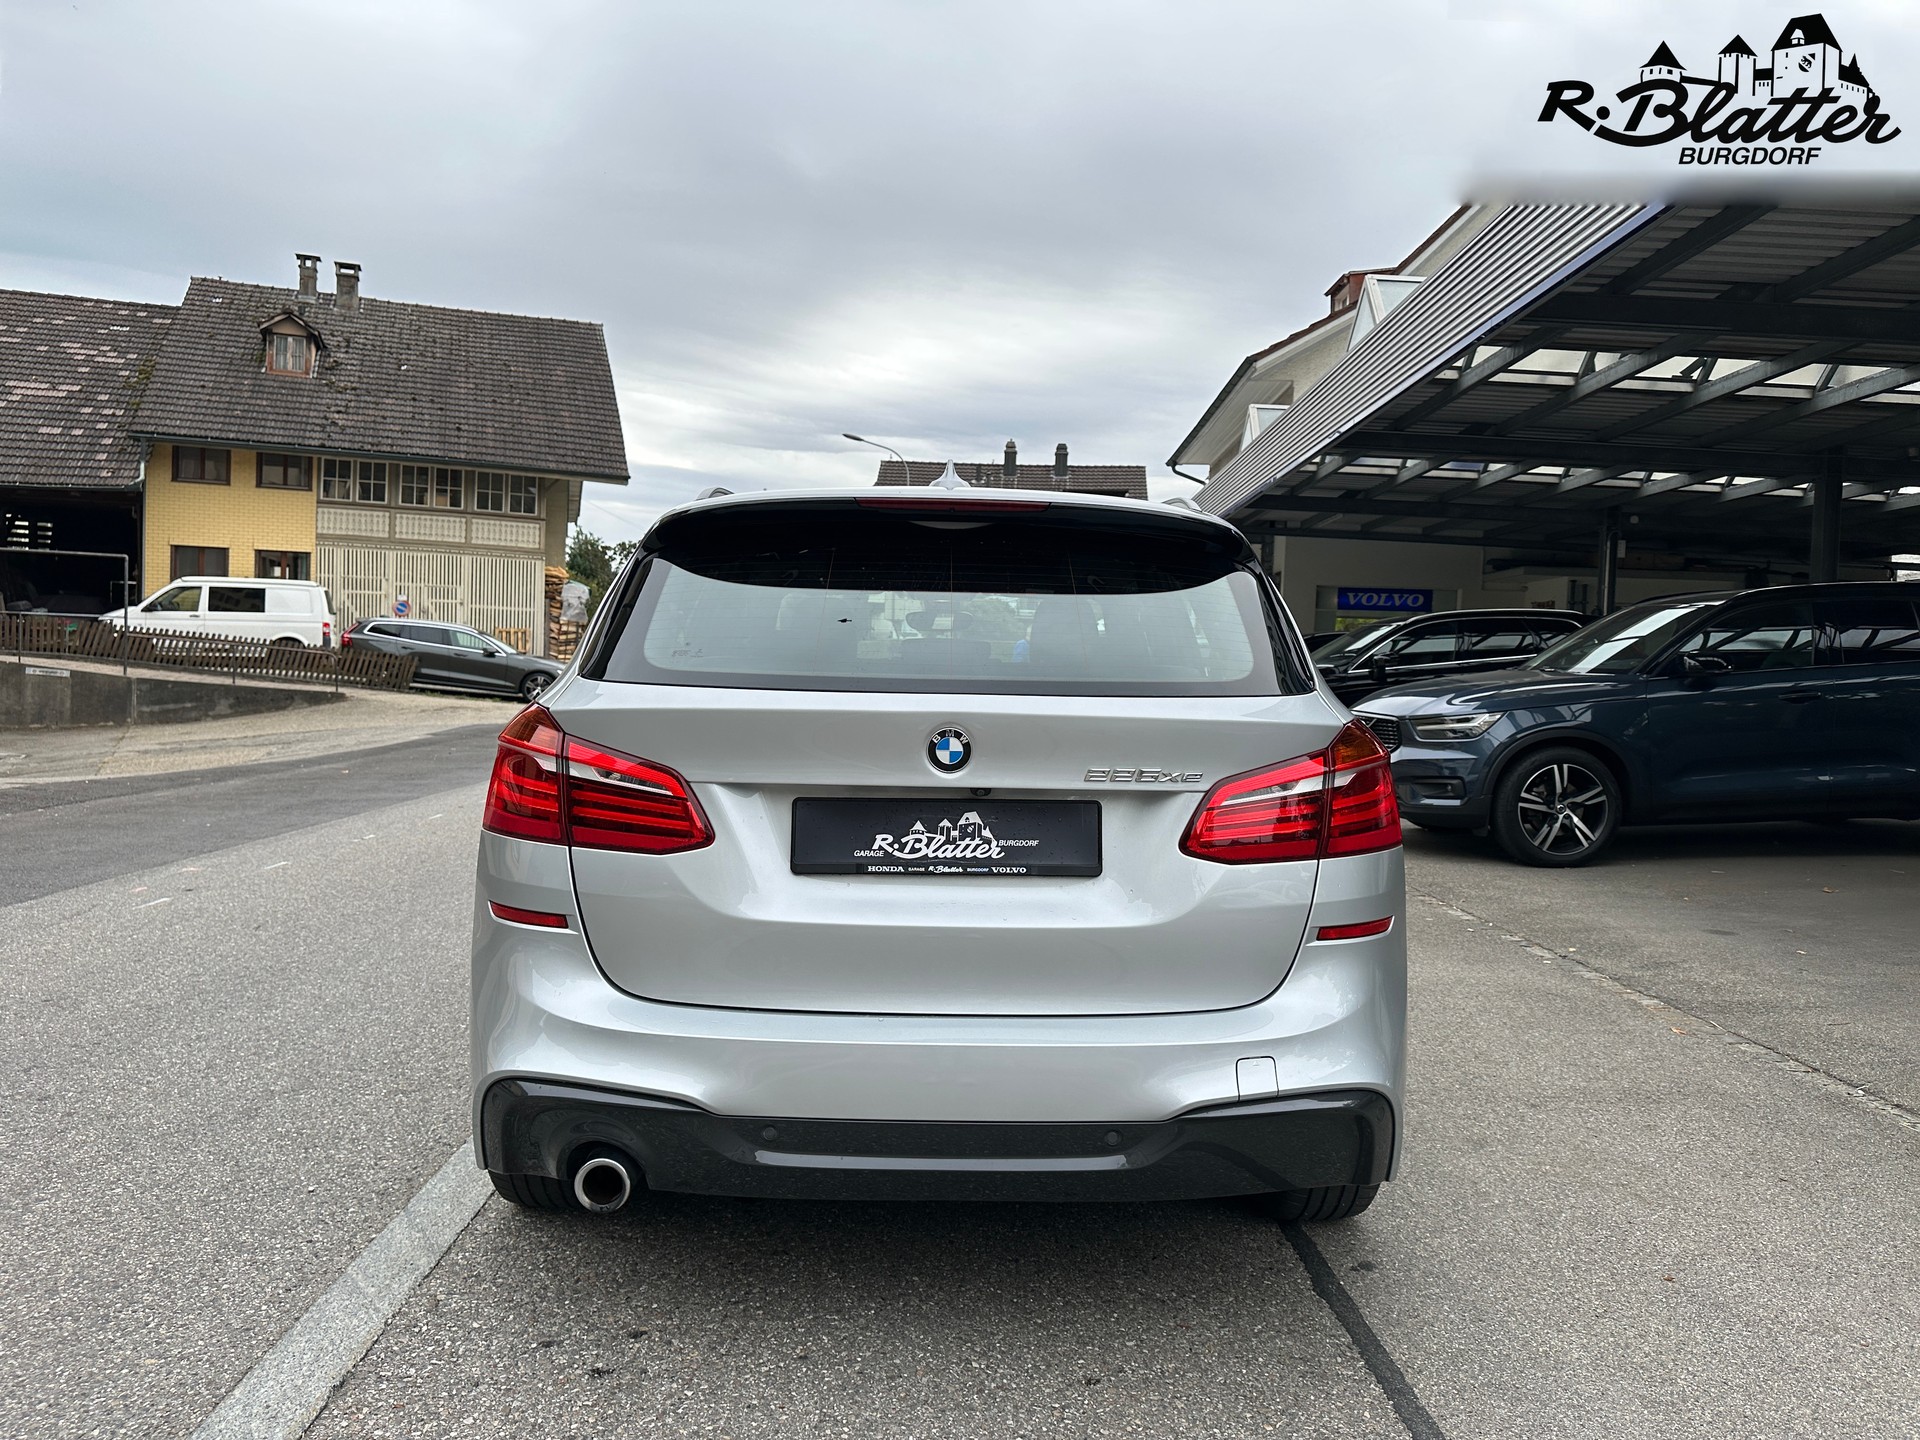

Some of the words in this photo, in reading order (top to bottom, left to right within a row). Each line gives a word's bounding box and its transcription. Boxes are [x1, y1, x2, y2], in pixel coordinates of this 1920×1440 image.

[1346, 592, 1425, 607] VOLVO
[1083, 768, 1203, 782] 225xe
[998, 839, 1039, 847] BURGDORF
